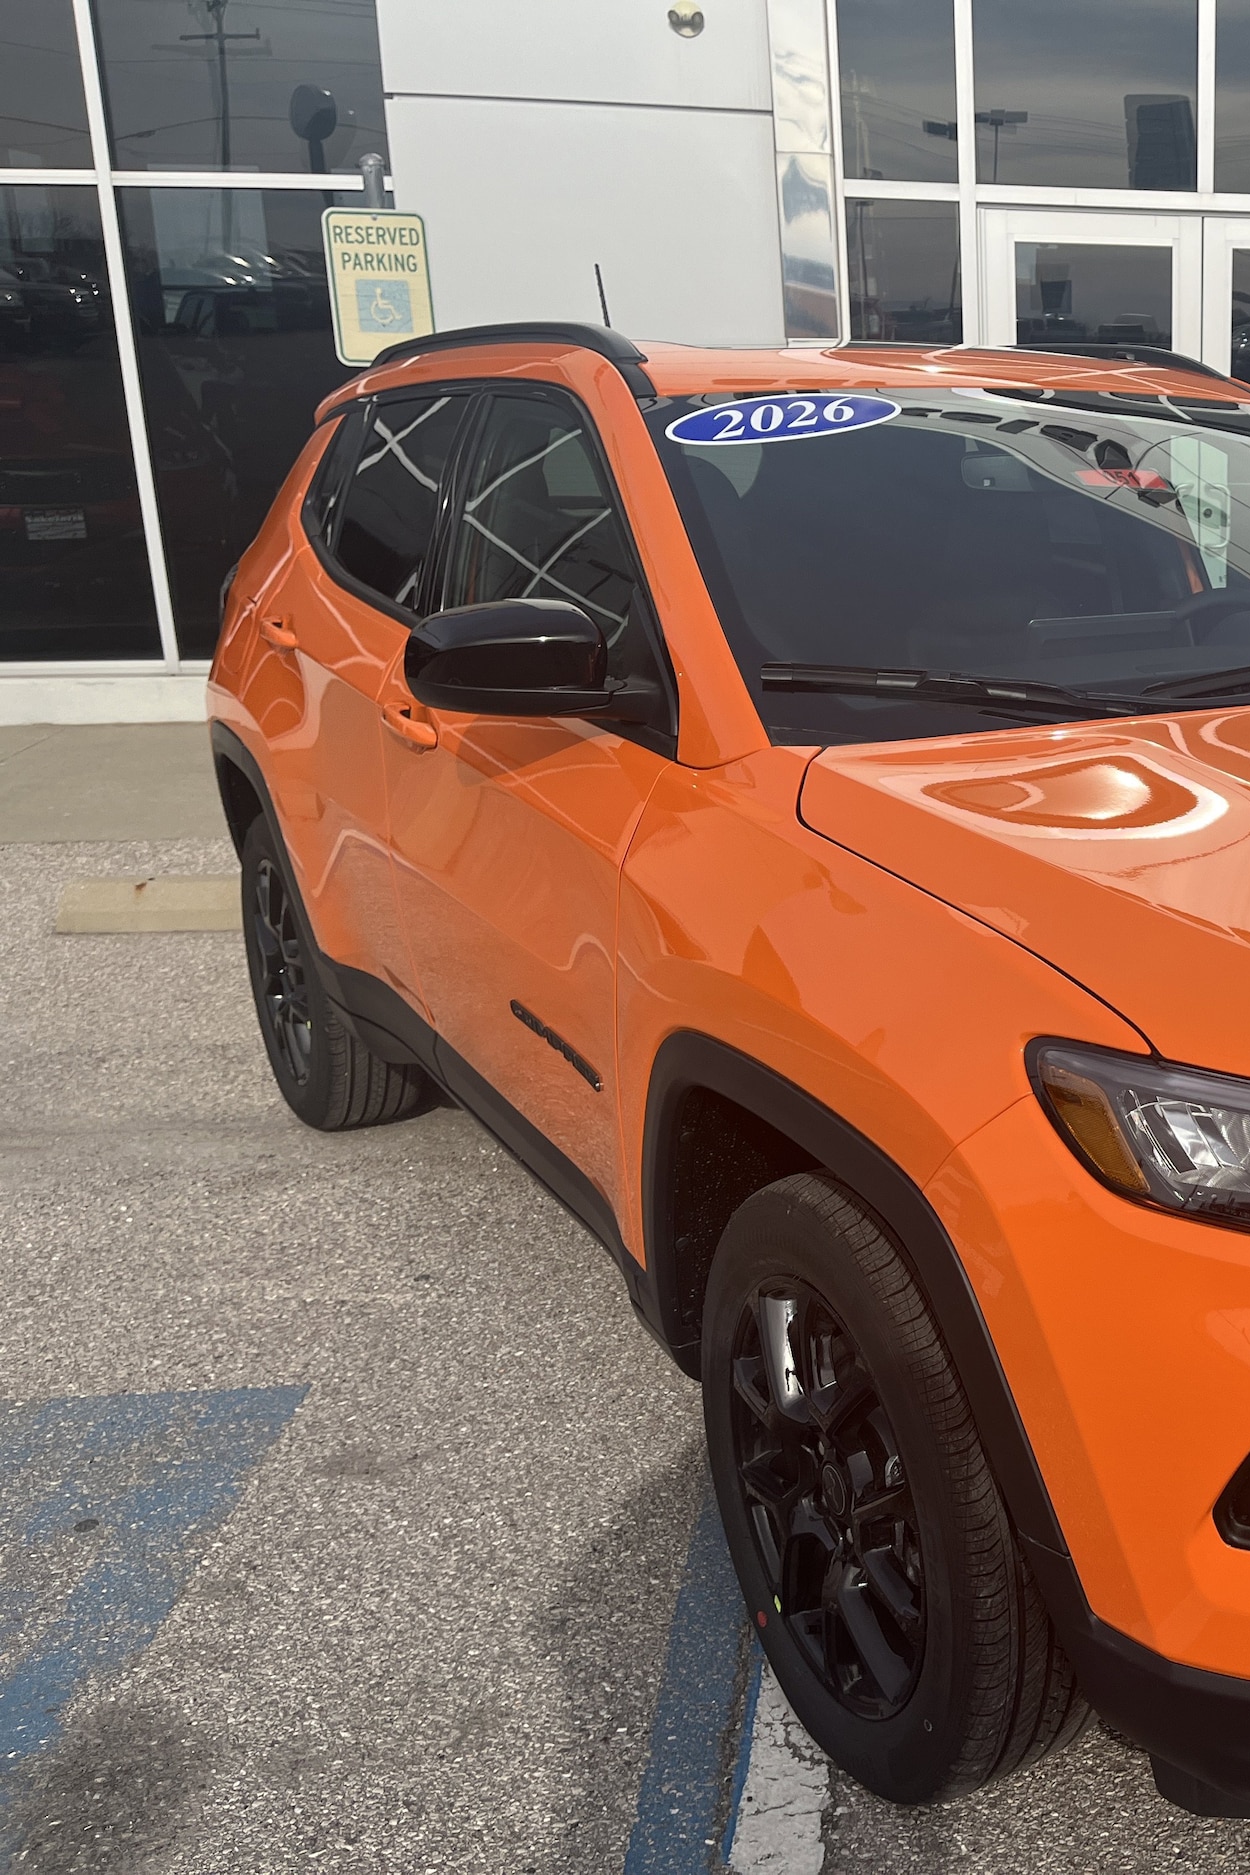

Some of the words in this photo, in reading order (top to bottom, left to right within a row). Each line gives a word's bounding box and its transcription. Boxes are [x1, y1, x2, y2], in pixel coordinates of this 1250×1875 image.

[332, 225, 420, 246] RESERVED
[341, 252, 418, 272] PARKING
[712, 397, 855, 440] 2026
